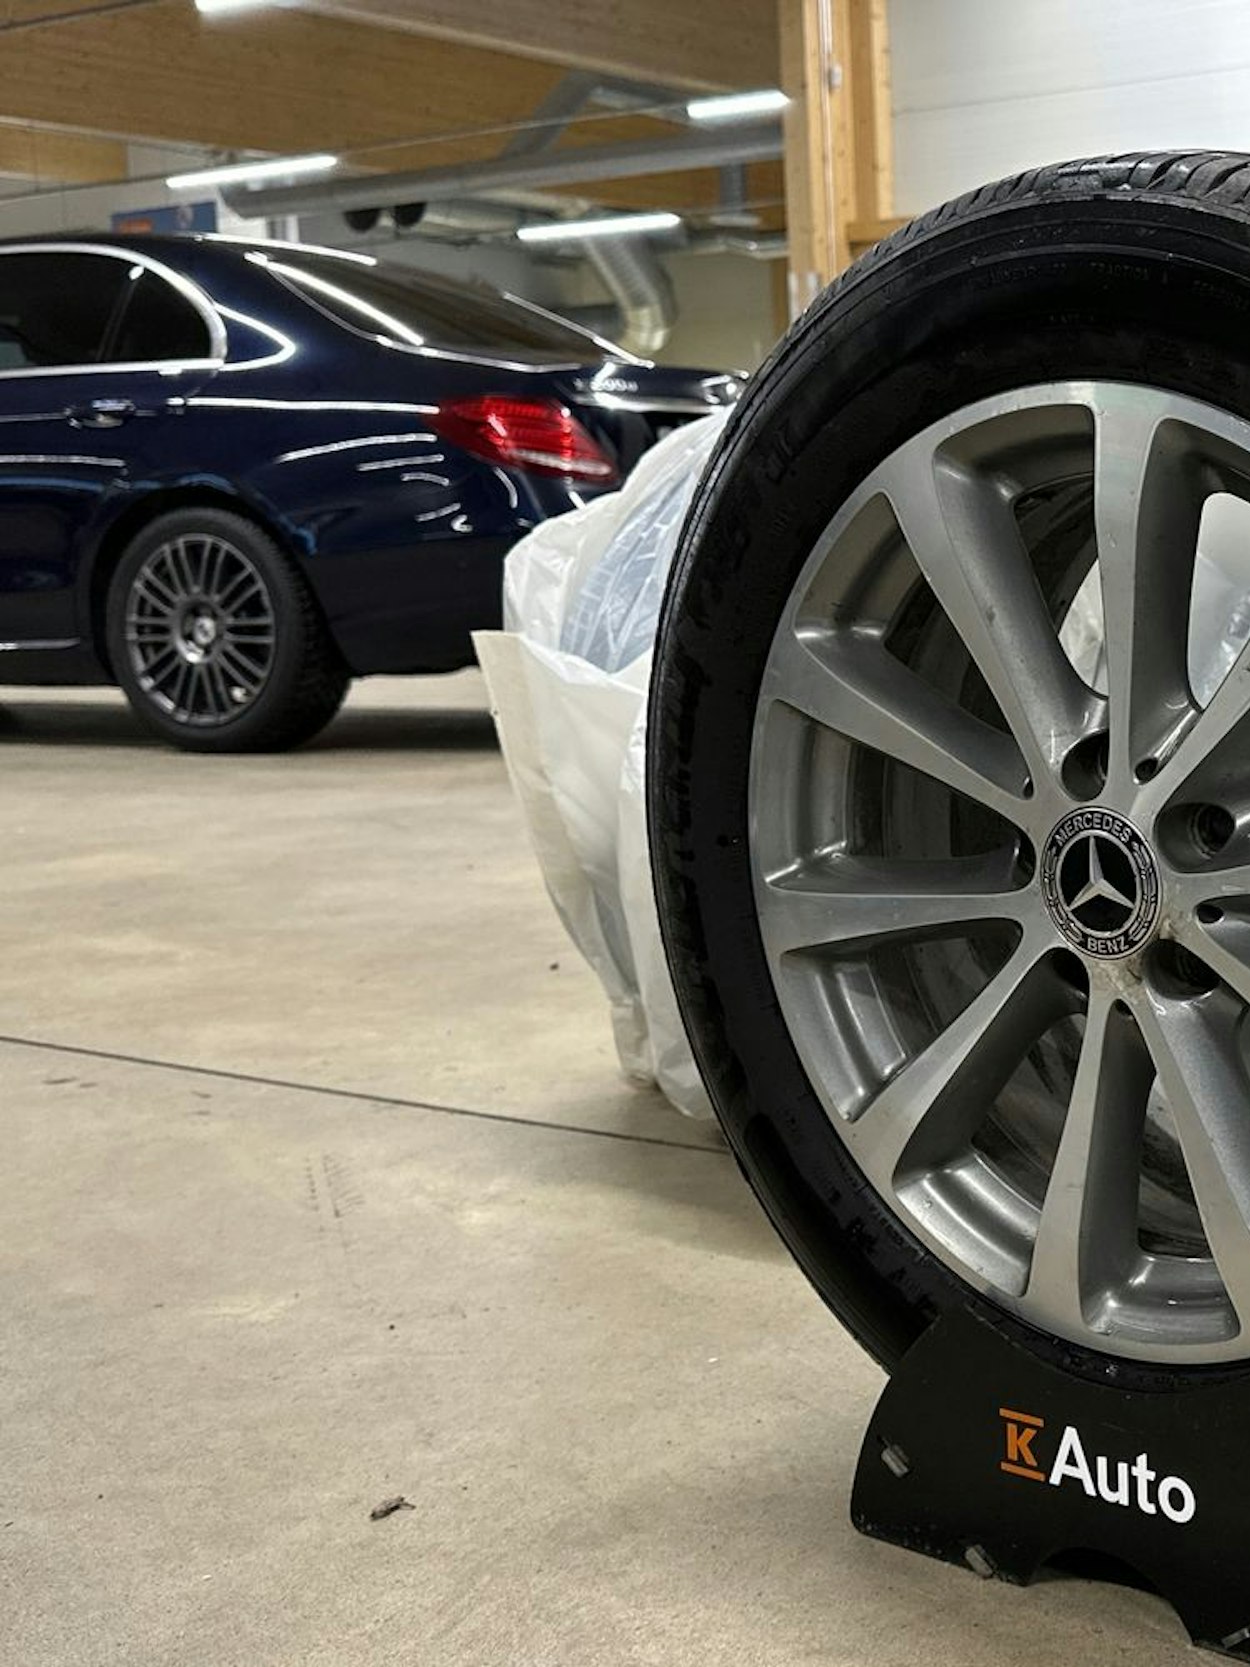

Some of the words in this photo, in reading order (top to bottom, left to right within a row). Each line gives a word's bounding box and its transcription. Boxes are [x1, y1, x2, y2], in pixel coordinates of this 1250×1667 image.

[1055, 813, 1132, 846] MERCEDES
[1087, 936, 1130, 954] BENZ
[1049, 1425, 1197, 1524] Auto
